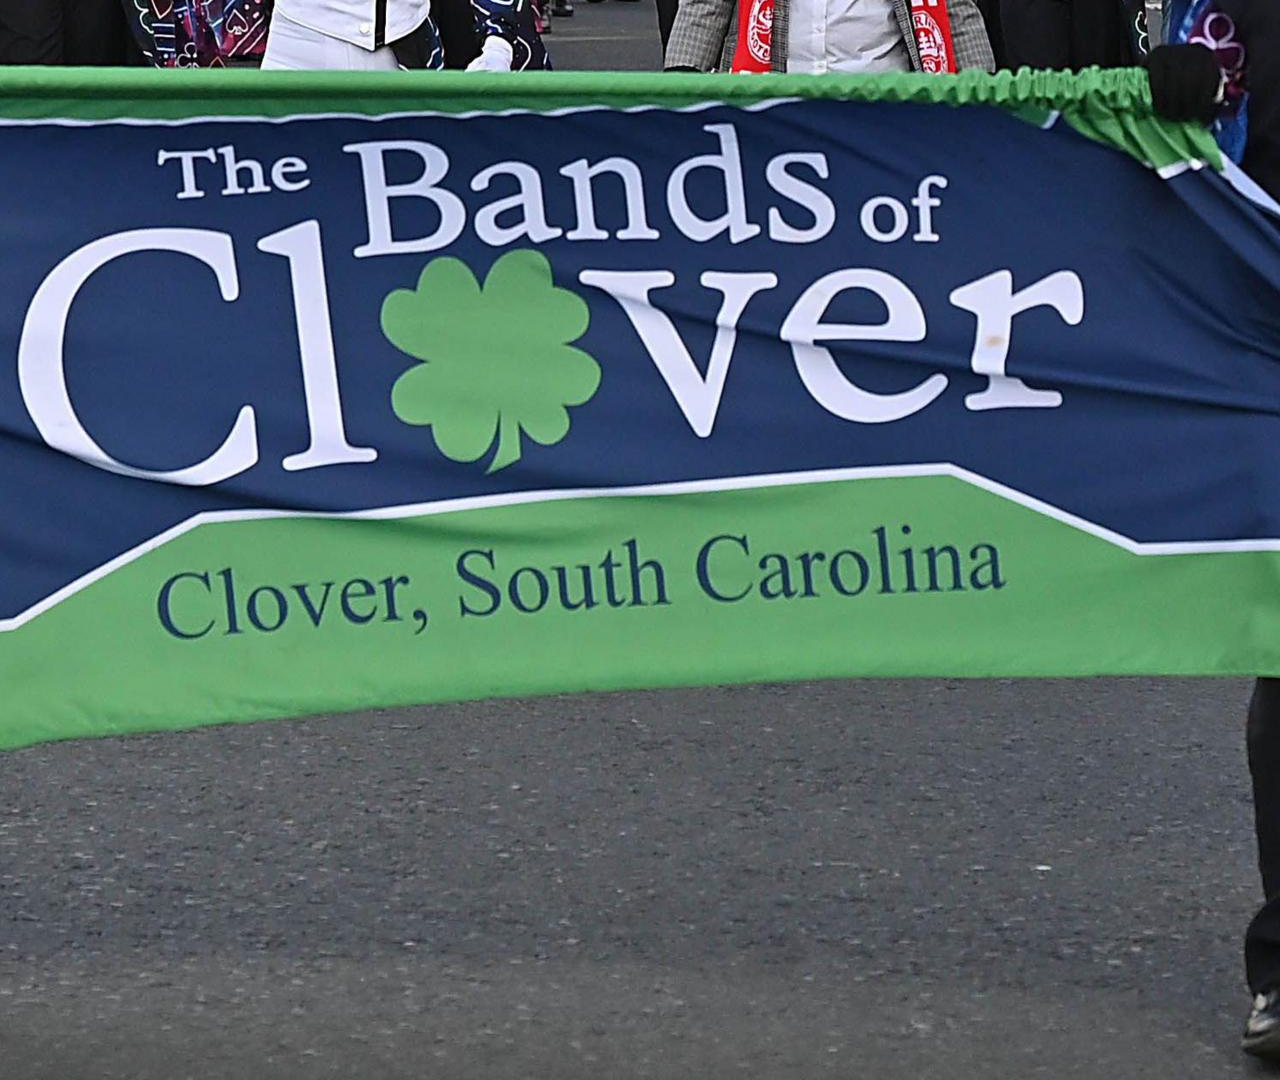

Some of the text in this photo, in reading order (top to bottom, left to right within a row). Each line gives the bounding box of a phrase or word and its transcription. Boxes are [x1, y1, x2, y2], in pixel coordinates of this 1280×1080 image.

[157, 123, 948, 258] The Bands of
[156, 524, 1008, 640] Clover, South Carolina
